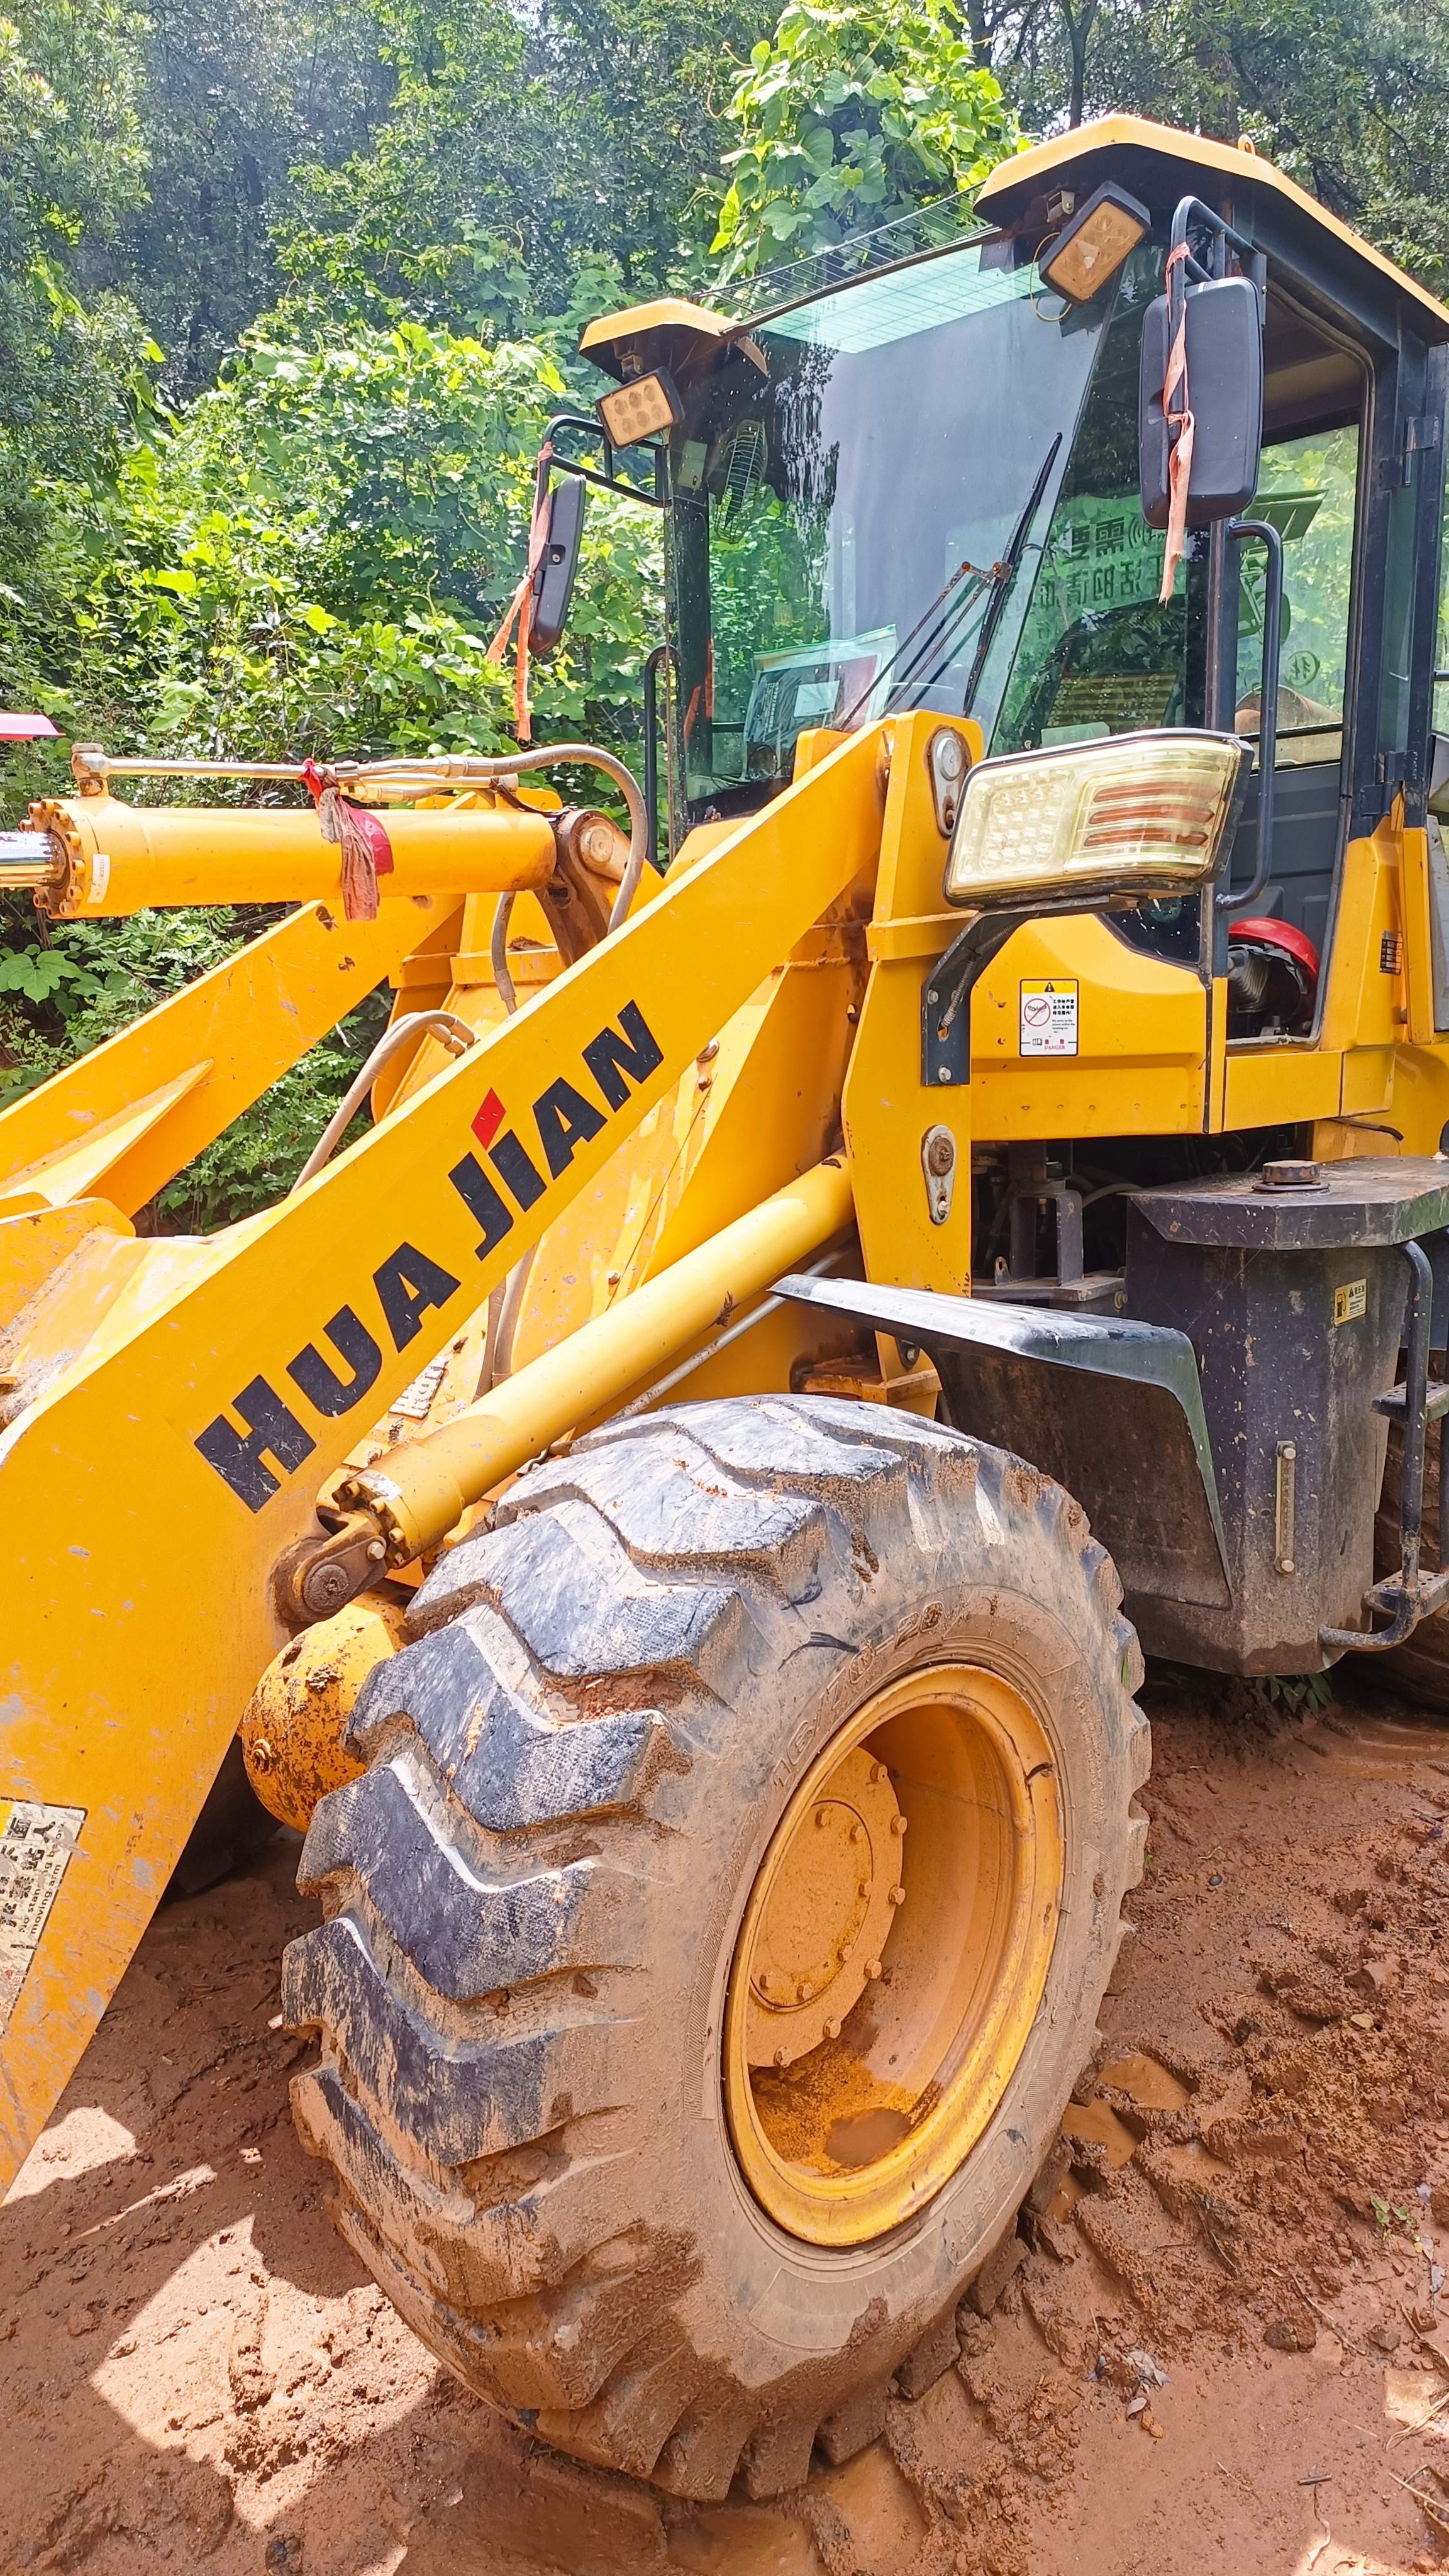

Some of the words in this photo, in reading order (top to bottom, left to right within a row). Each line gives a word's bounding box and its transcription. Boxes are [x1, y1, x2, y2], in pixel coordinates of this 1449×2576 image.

[194, 1241, 461, 1513] HUA
[28, 1861, 53, 1913] stanng
[31, 1890, 53, 1935] moving
[48, 1863, 62, 1887] arm
